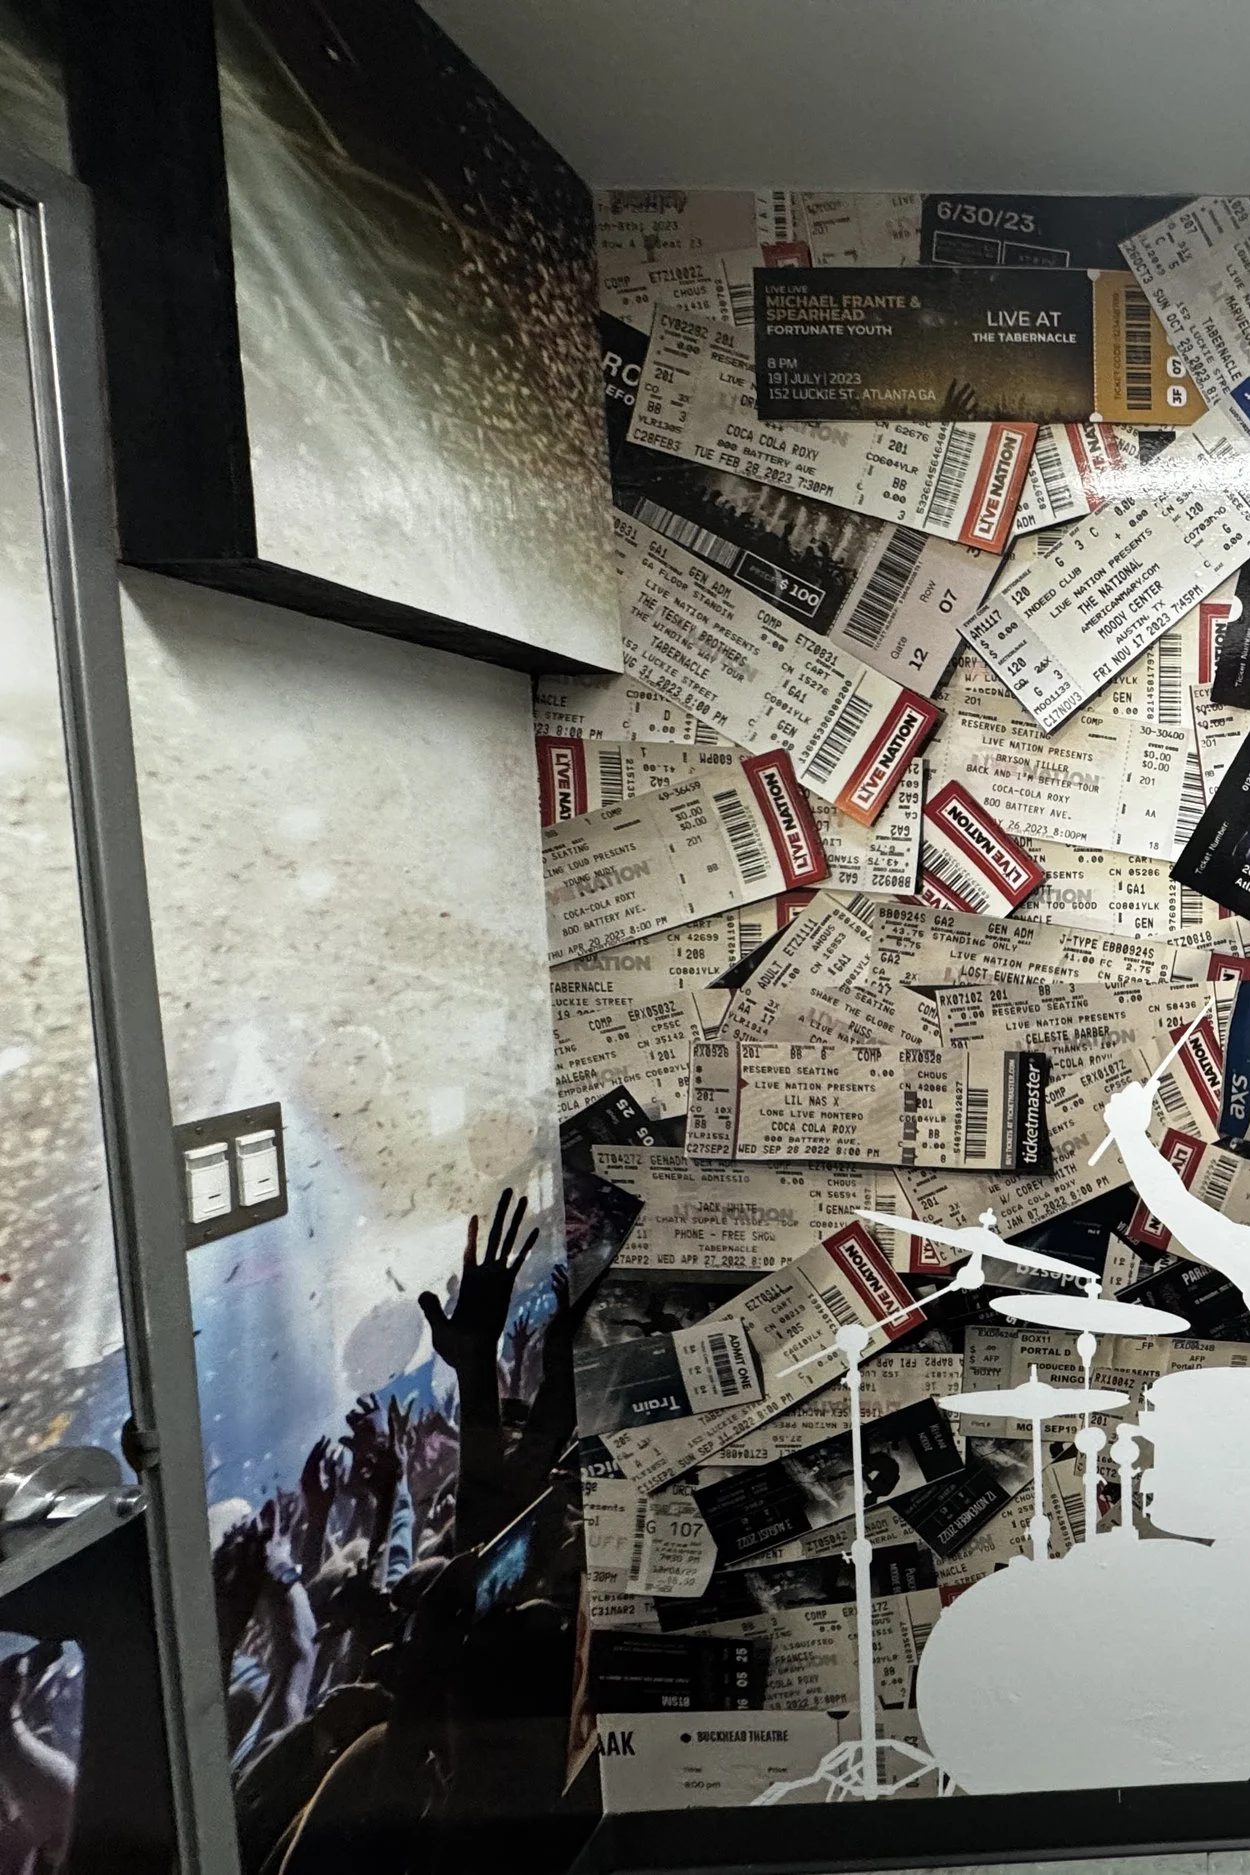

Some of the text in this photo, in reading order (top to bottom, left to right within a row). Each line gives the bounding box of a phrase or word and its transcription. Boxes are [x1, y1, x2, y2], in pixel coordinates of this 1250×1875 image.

[937, 201, 1037, 233] 6/30/23
[766, 296, 921, 309] MICHAEL FRANTE &
[766, 308, 864, 322] SPEARHEAD
[767, 325, 892, 336] FORTUNATE YOUTH
[987, 312, 1061, 326] LIVE AT
[972, 332, 1077, 343] THE TABERNACLE
[1202, 316, 1243, 382] TABERNACLE
[768, 389, 791, 400] 152
[793, 389, 835, 400] LUCKIE
[862, 389, 916, 400] ATLANTA
[725, 425, 819, 462] COCA COLA ROXY
[976, 436, 1017, 536] LIVE NATION
[939, 589, 956, 614] 07
[1077, 559, 1144, 615] THE NATIONAL
[1080, 564, 1160, 633] AMERICANMARY.COM
[1098, 580, 1164, 640] MOODY CENTER
[638, 592, 748, 668] THE TESKEY BROTHERS
[650, 635, 710, 680] TABERNACLE
[909, 648, 928, 671] 12
[1093, 663, 1111, 682] FRI
[1114, 648, 1134, 670] NOV
[1134, 634, 1153, 651] 17
[1146, 615, 1172, 638] 2023
[857, 710, 919, 806] LIVE NATION
[996, 752, 1069, 773] BRYSON TILLER
[761, 771, 808, 869] NATION LIVE
[947, 805, 1023, 885] NATION LIVE
[1195, 847, 1217, 875] Ticket
[848, 1021, 873, 1039] RUSS
[1025, 1026, 1110, 1044] CELESTE BARBER
[784, 1095, 840, 1107] LIL NAS X
[1229, 1073, 1248, 1120] axs
[1022, 1064, 1042, 1164] ticketmaster
[845, 1244, 883, 1301] NATION
[728, 1334, 752, 1390] ADMIT ONE
[1020, 1347, 1062, 1356] PORTAL
[1050, 1375, 1085, 1384] RINGO
[632, 1395, 681, 1413] Train
[697, 1730, 789, 1742] BUCKHEAD THEATRE
